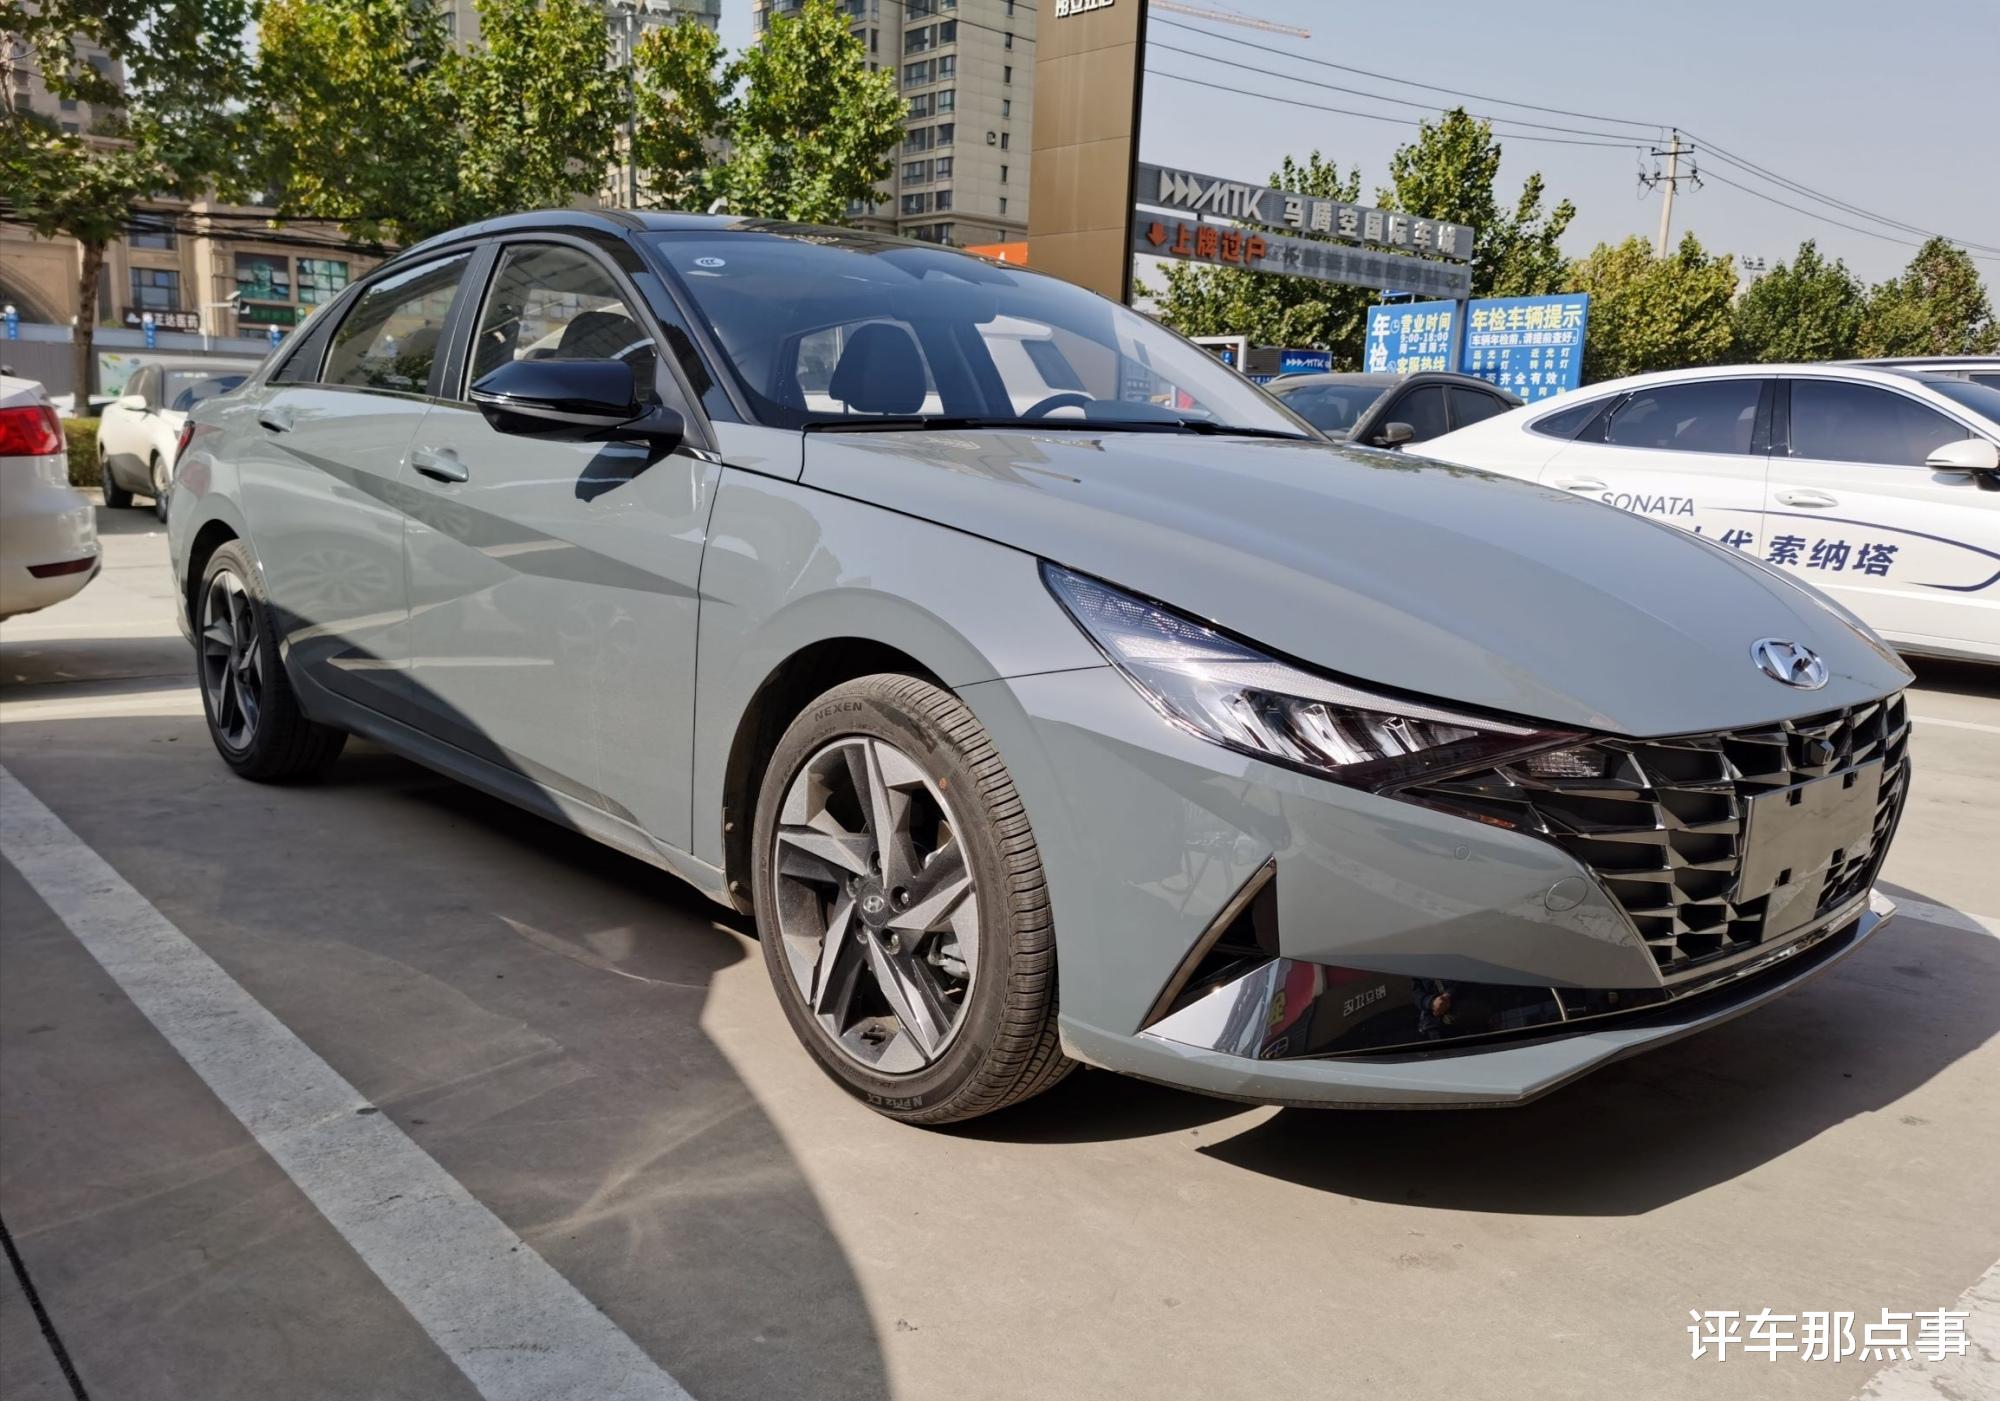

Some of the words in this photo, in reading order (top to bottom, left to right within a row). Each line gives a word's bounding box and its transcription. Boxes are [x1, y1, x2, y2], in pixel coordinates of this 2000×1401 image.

[1169, 222, 1267, 265] 上牌过户
[1401, 312, 1451, 333] 营业时间
[1471, 304, 1582, 331] 年检车辆提示
[1369, 313, 1391, 374] 年检
[1601, 492, 1695, 516] SONATA
[1695, 526, 1899, 577] 代索纳塔
[814, 702, 862, 722] NEXEN
